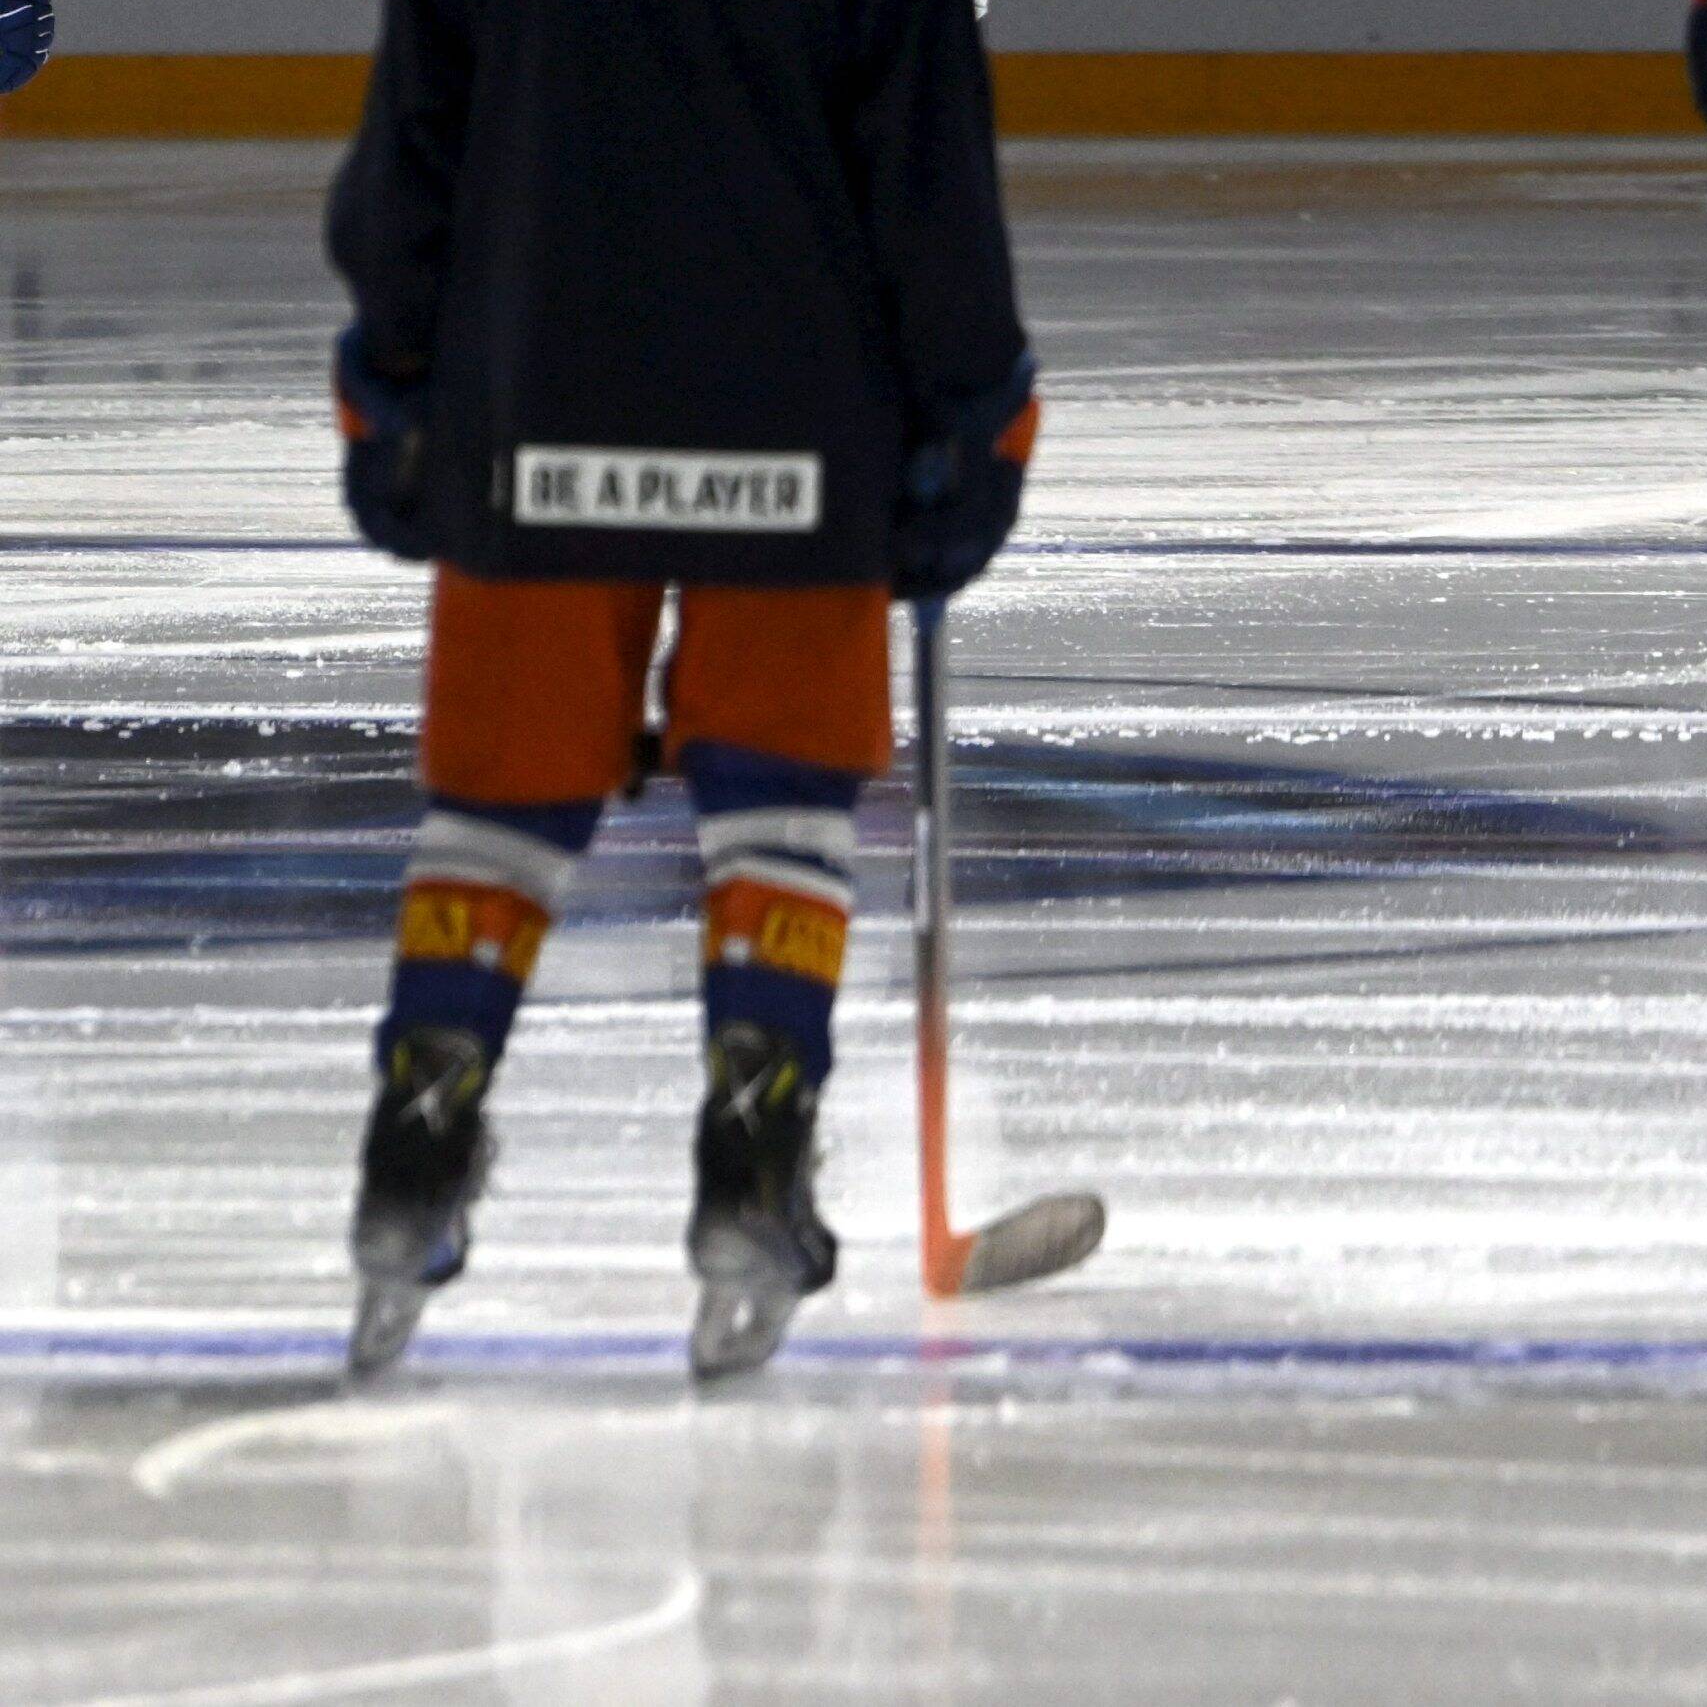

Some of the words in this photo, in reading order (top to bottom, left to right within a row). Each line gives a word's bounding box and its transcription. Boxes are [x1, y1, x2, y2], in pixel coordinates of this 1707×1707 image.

[531, 461, 580, 511] BE
[596, 462, 624, 510] A
[637, 464, 802, 516] PLAYER
